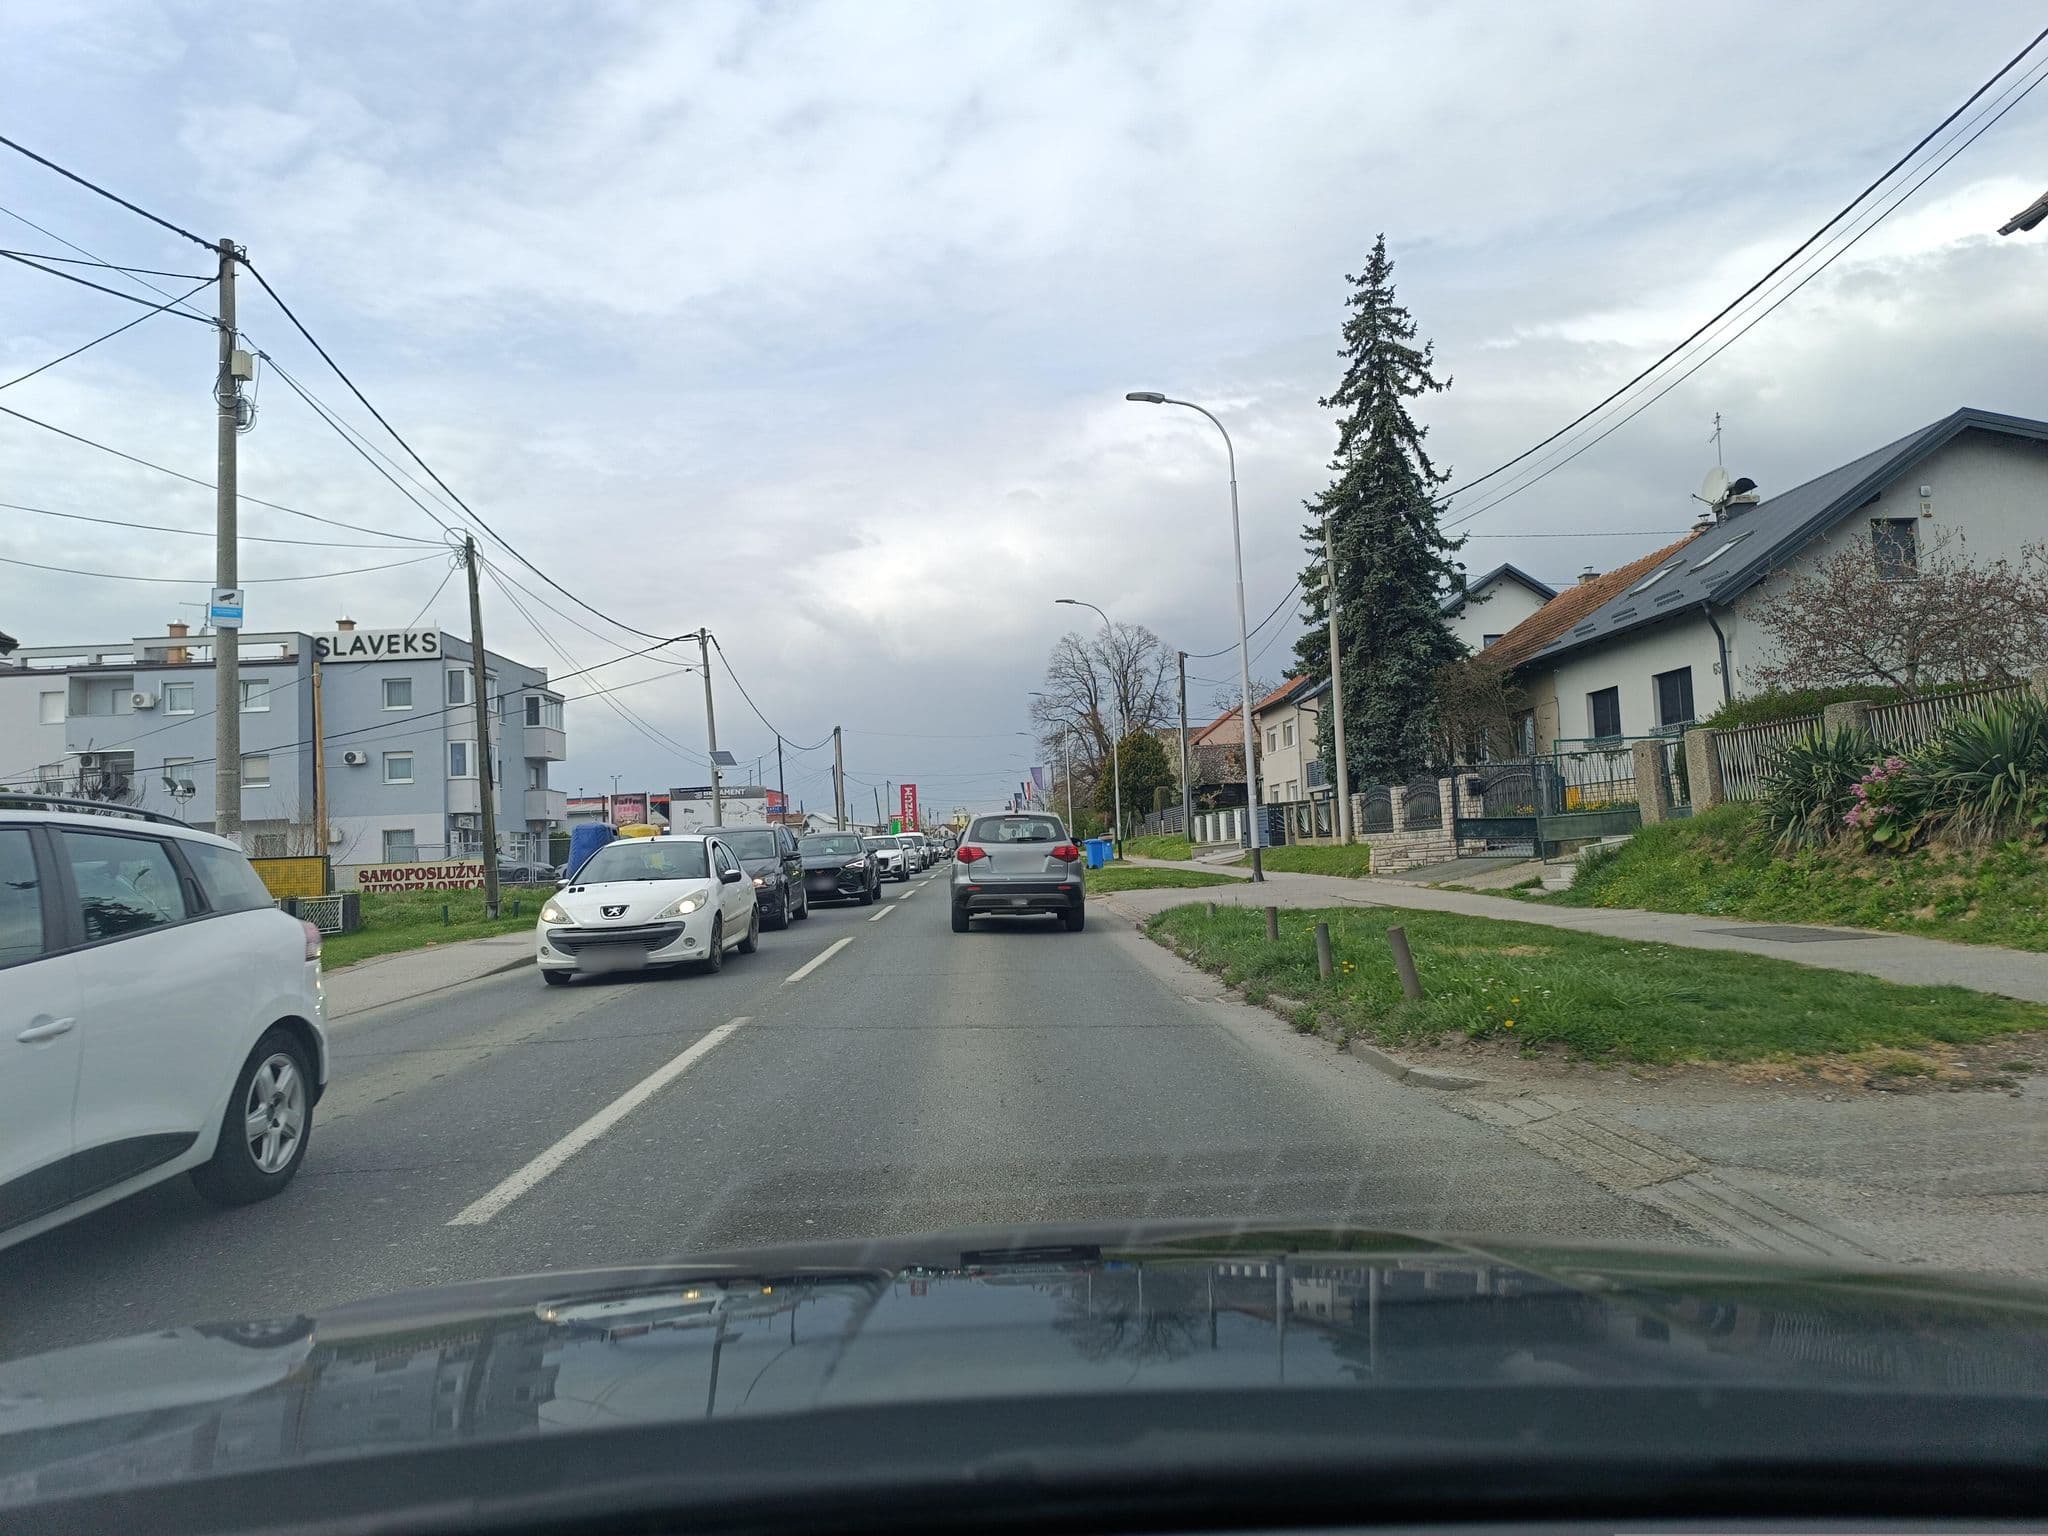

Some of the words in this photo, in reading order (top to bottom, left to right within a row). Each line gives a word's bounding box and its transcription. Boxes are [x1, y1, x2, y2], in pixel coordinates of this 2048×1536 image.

[315, 632, 437, 658] SLAVEKS
[703, 788, 746, 796] BEAMENT
[904, 787, 914, 831] KONZUM
[359, 862, 485, 883] SAMOPOSLUŽNA
